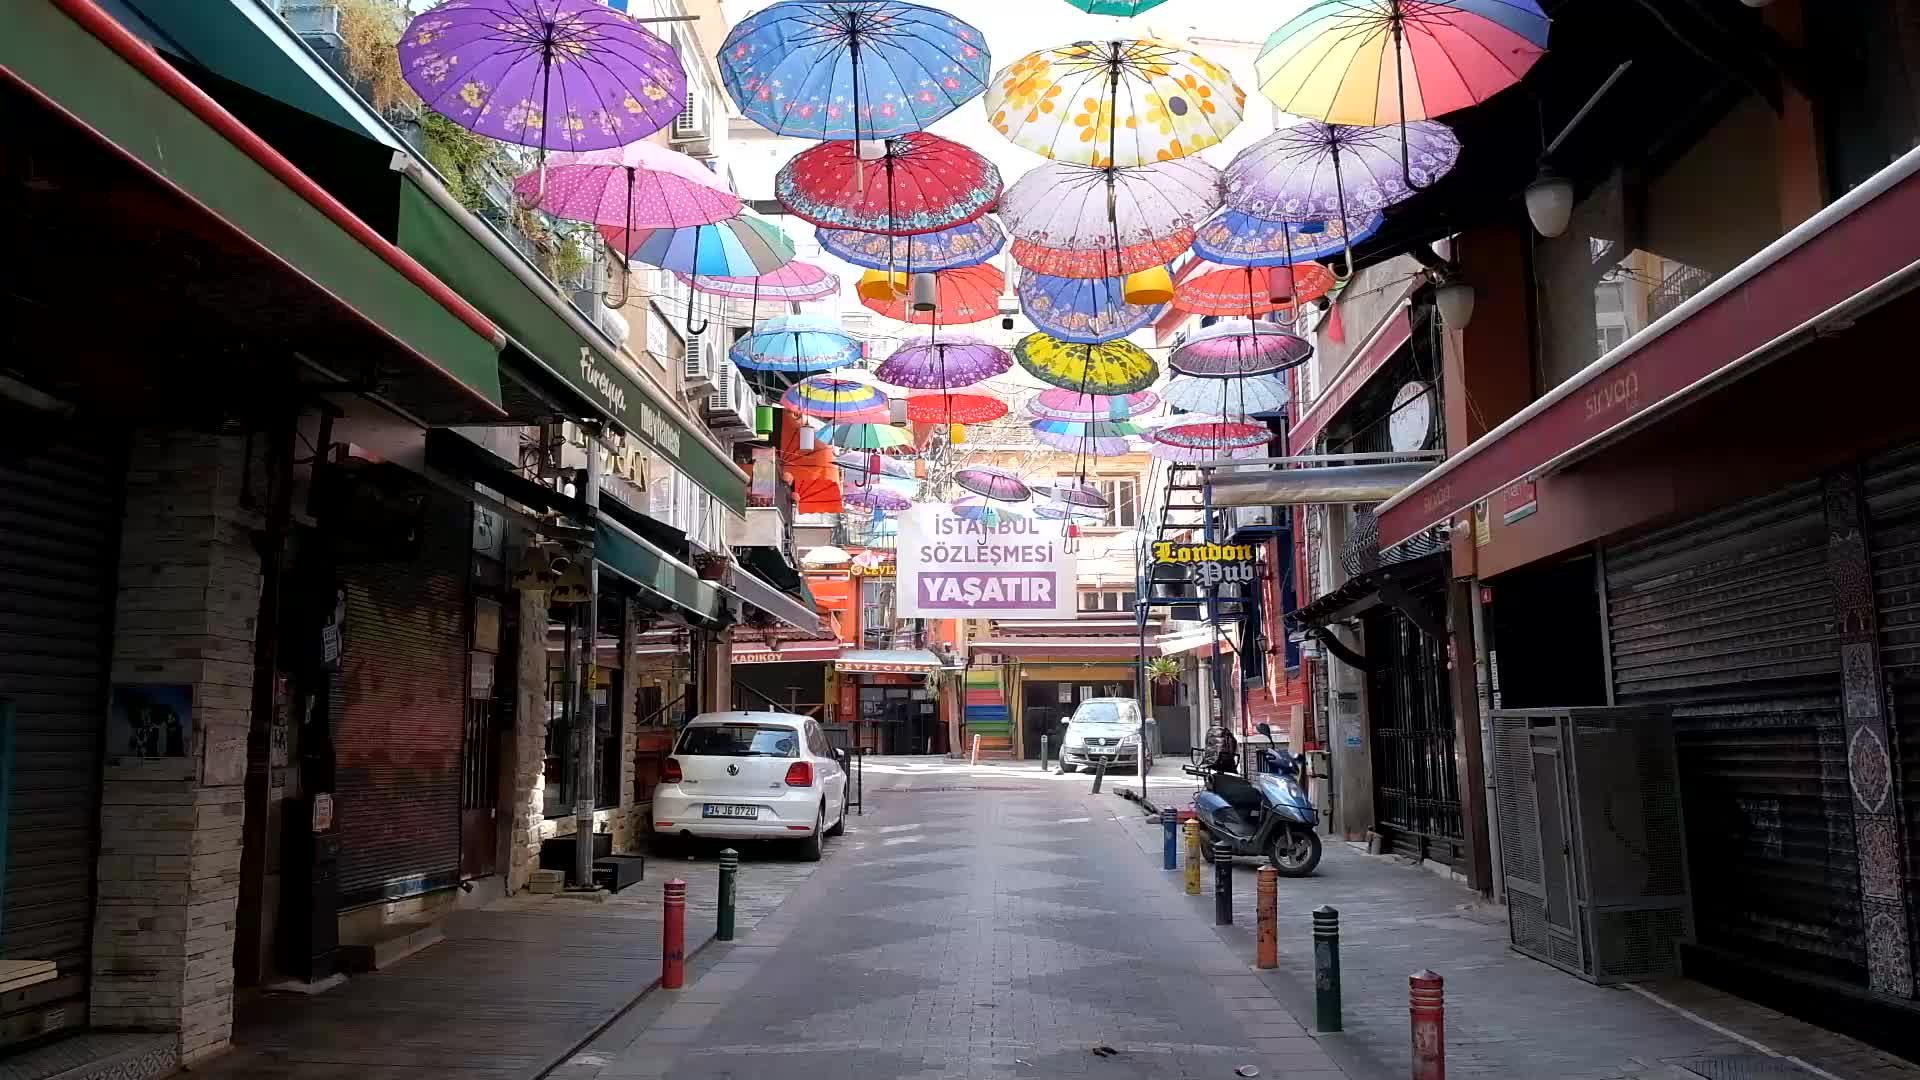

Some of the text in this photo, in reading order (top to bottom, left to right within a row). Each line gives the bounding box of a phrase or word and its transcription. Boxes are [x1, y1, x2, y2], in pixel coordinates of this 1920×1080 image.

[920, 541, 1053, 566] SÖZLEŞMESİ
[1154, 541, 1254, 564] London
[1195, 561, 1255, 587] Pub
[923, 577, 1052, 607] YAŞATIR
[709, 806, 720, 815] 34
